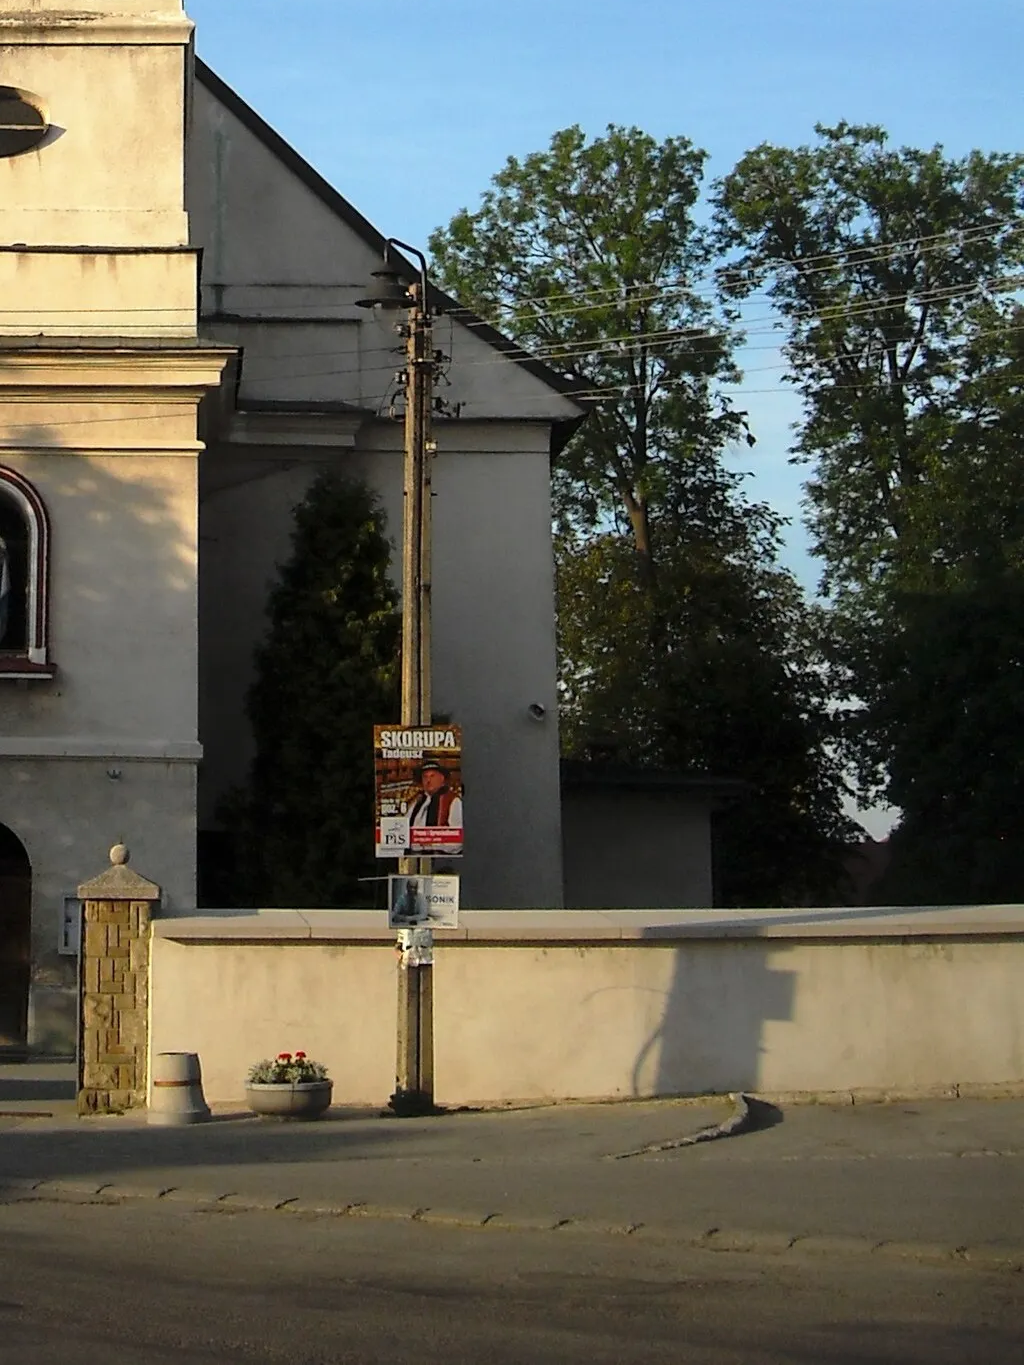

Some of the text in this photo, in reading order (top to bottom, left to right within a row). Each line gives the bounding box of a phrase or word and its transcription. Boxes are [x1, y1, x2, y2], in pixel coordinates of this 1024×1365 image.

[380, 730, 456, 748] SKORUPA
[382, 749, 423, 759] Tadeusz
[426, 895, 454, 904] SONIK
